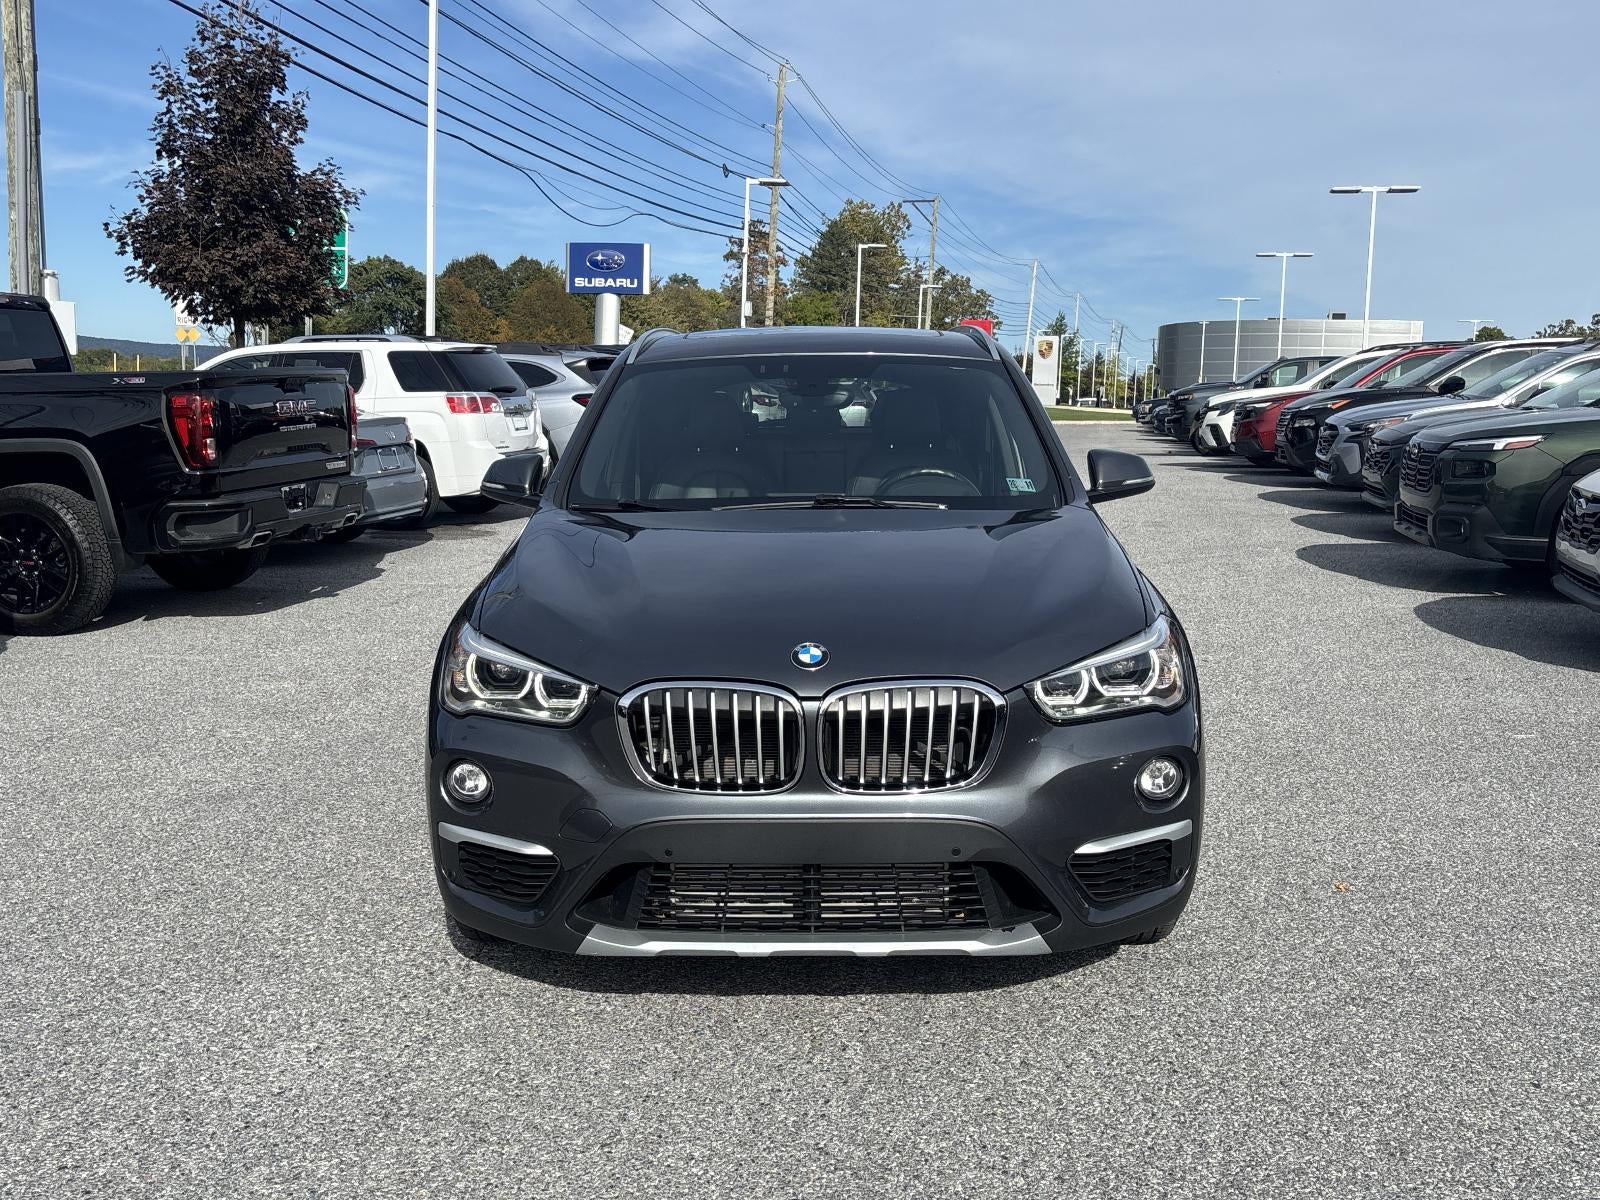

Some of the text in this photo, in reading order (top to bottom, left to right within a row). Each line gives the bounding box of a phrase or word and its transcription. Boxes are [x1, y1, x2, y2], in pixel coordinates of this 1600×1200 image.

[574, 277, 638, 288] SUBARU
[177, 316, 196, 324] RIGH
[276, 399, 317, 417] GMC
